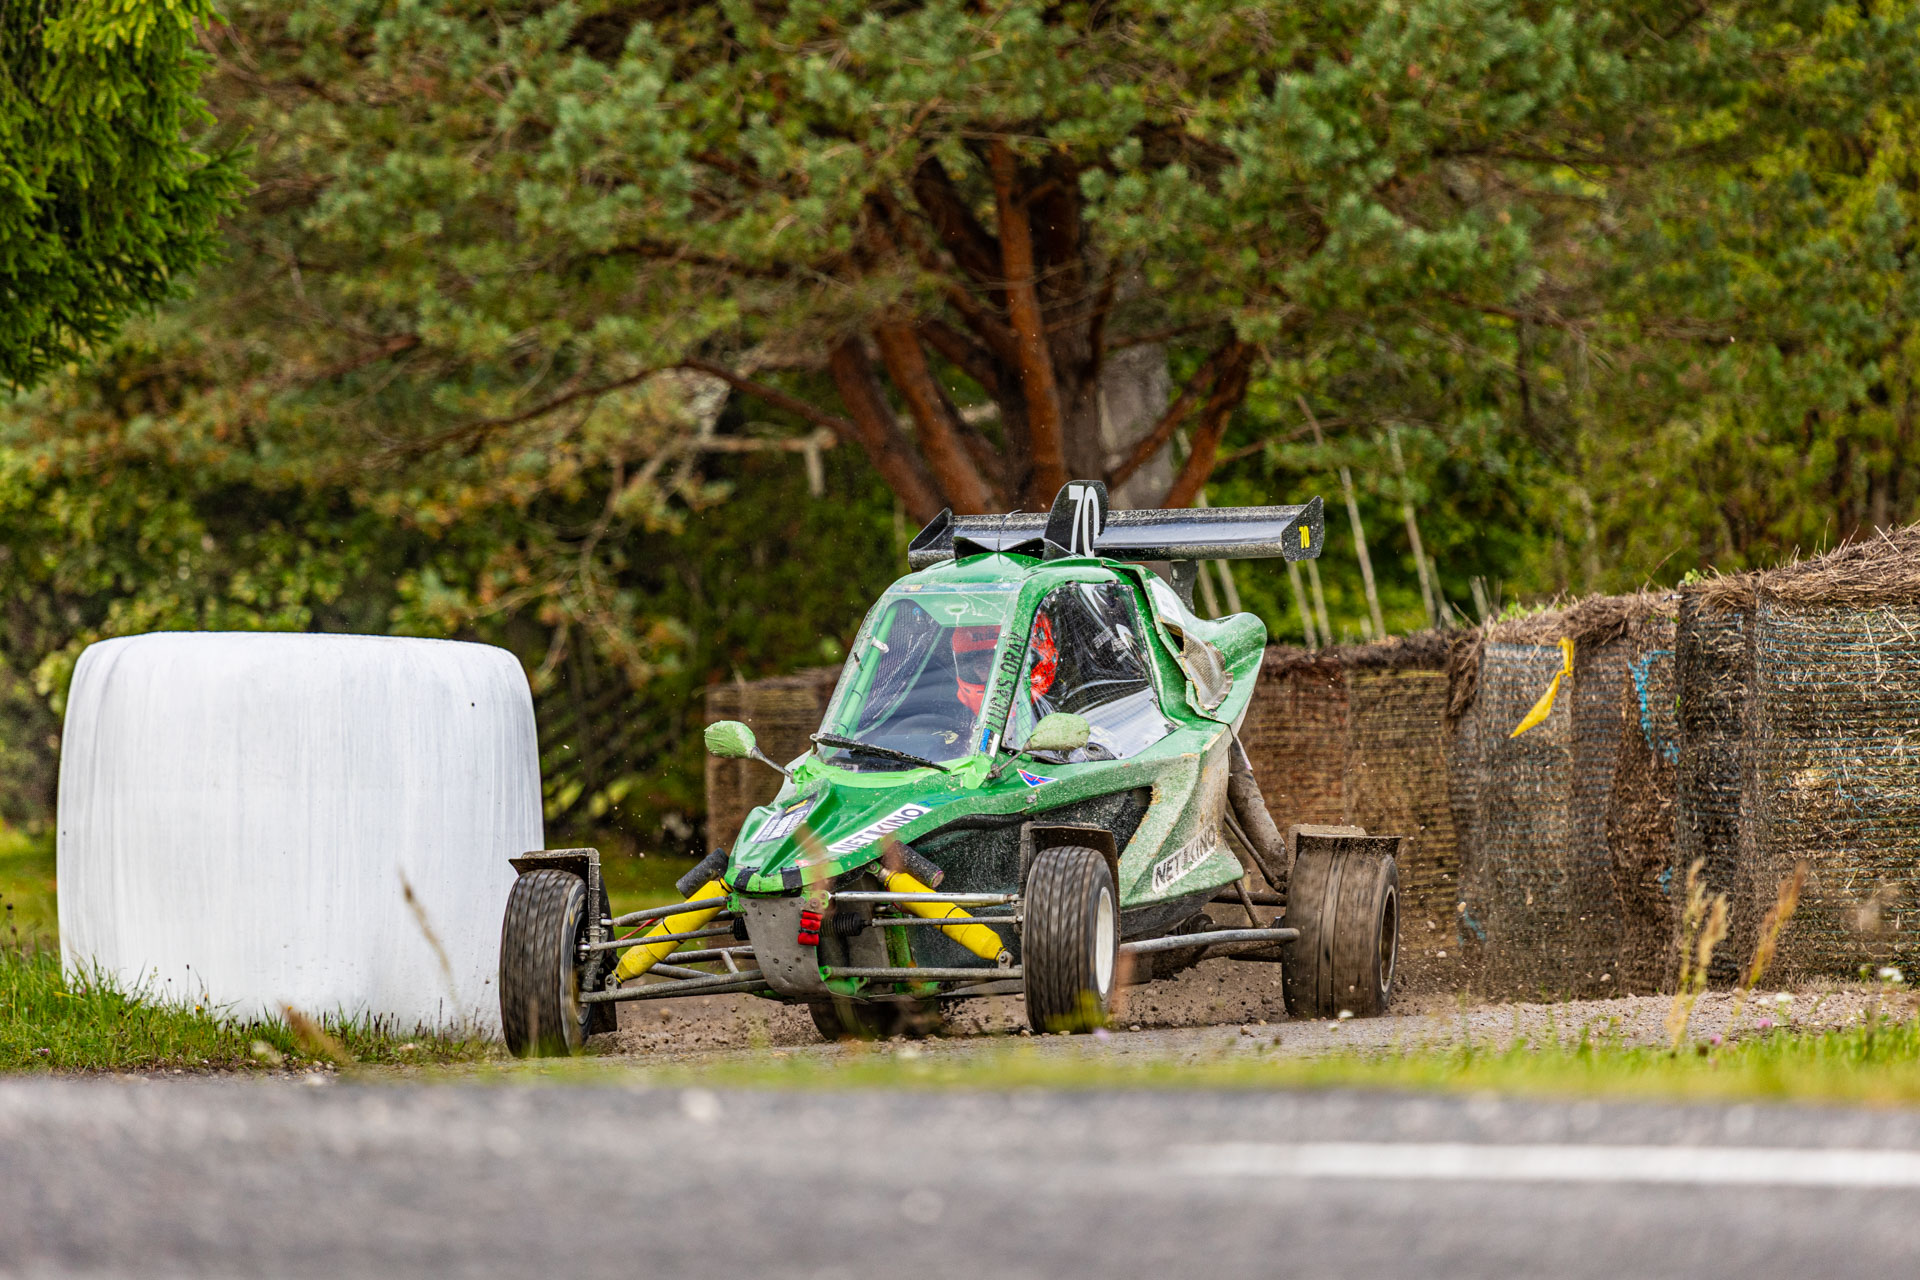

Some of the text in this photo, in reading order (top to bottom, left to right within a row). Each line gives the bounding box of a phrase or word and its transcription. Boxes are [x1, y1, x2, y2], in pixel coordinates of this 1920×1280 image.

[1068, 485, 1100, 558] 70
[1298, 525, 1310, 549] 70
[985, 631, 1026, 731] LUCAS ORAV
